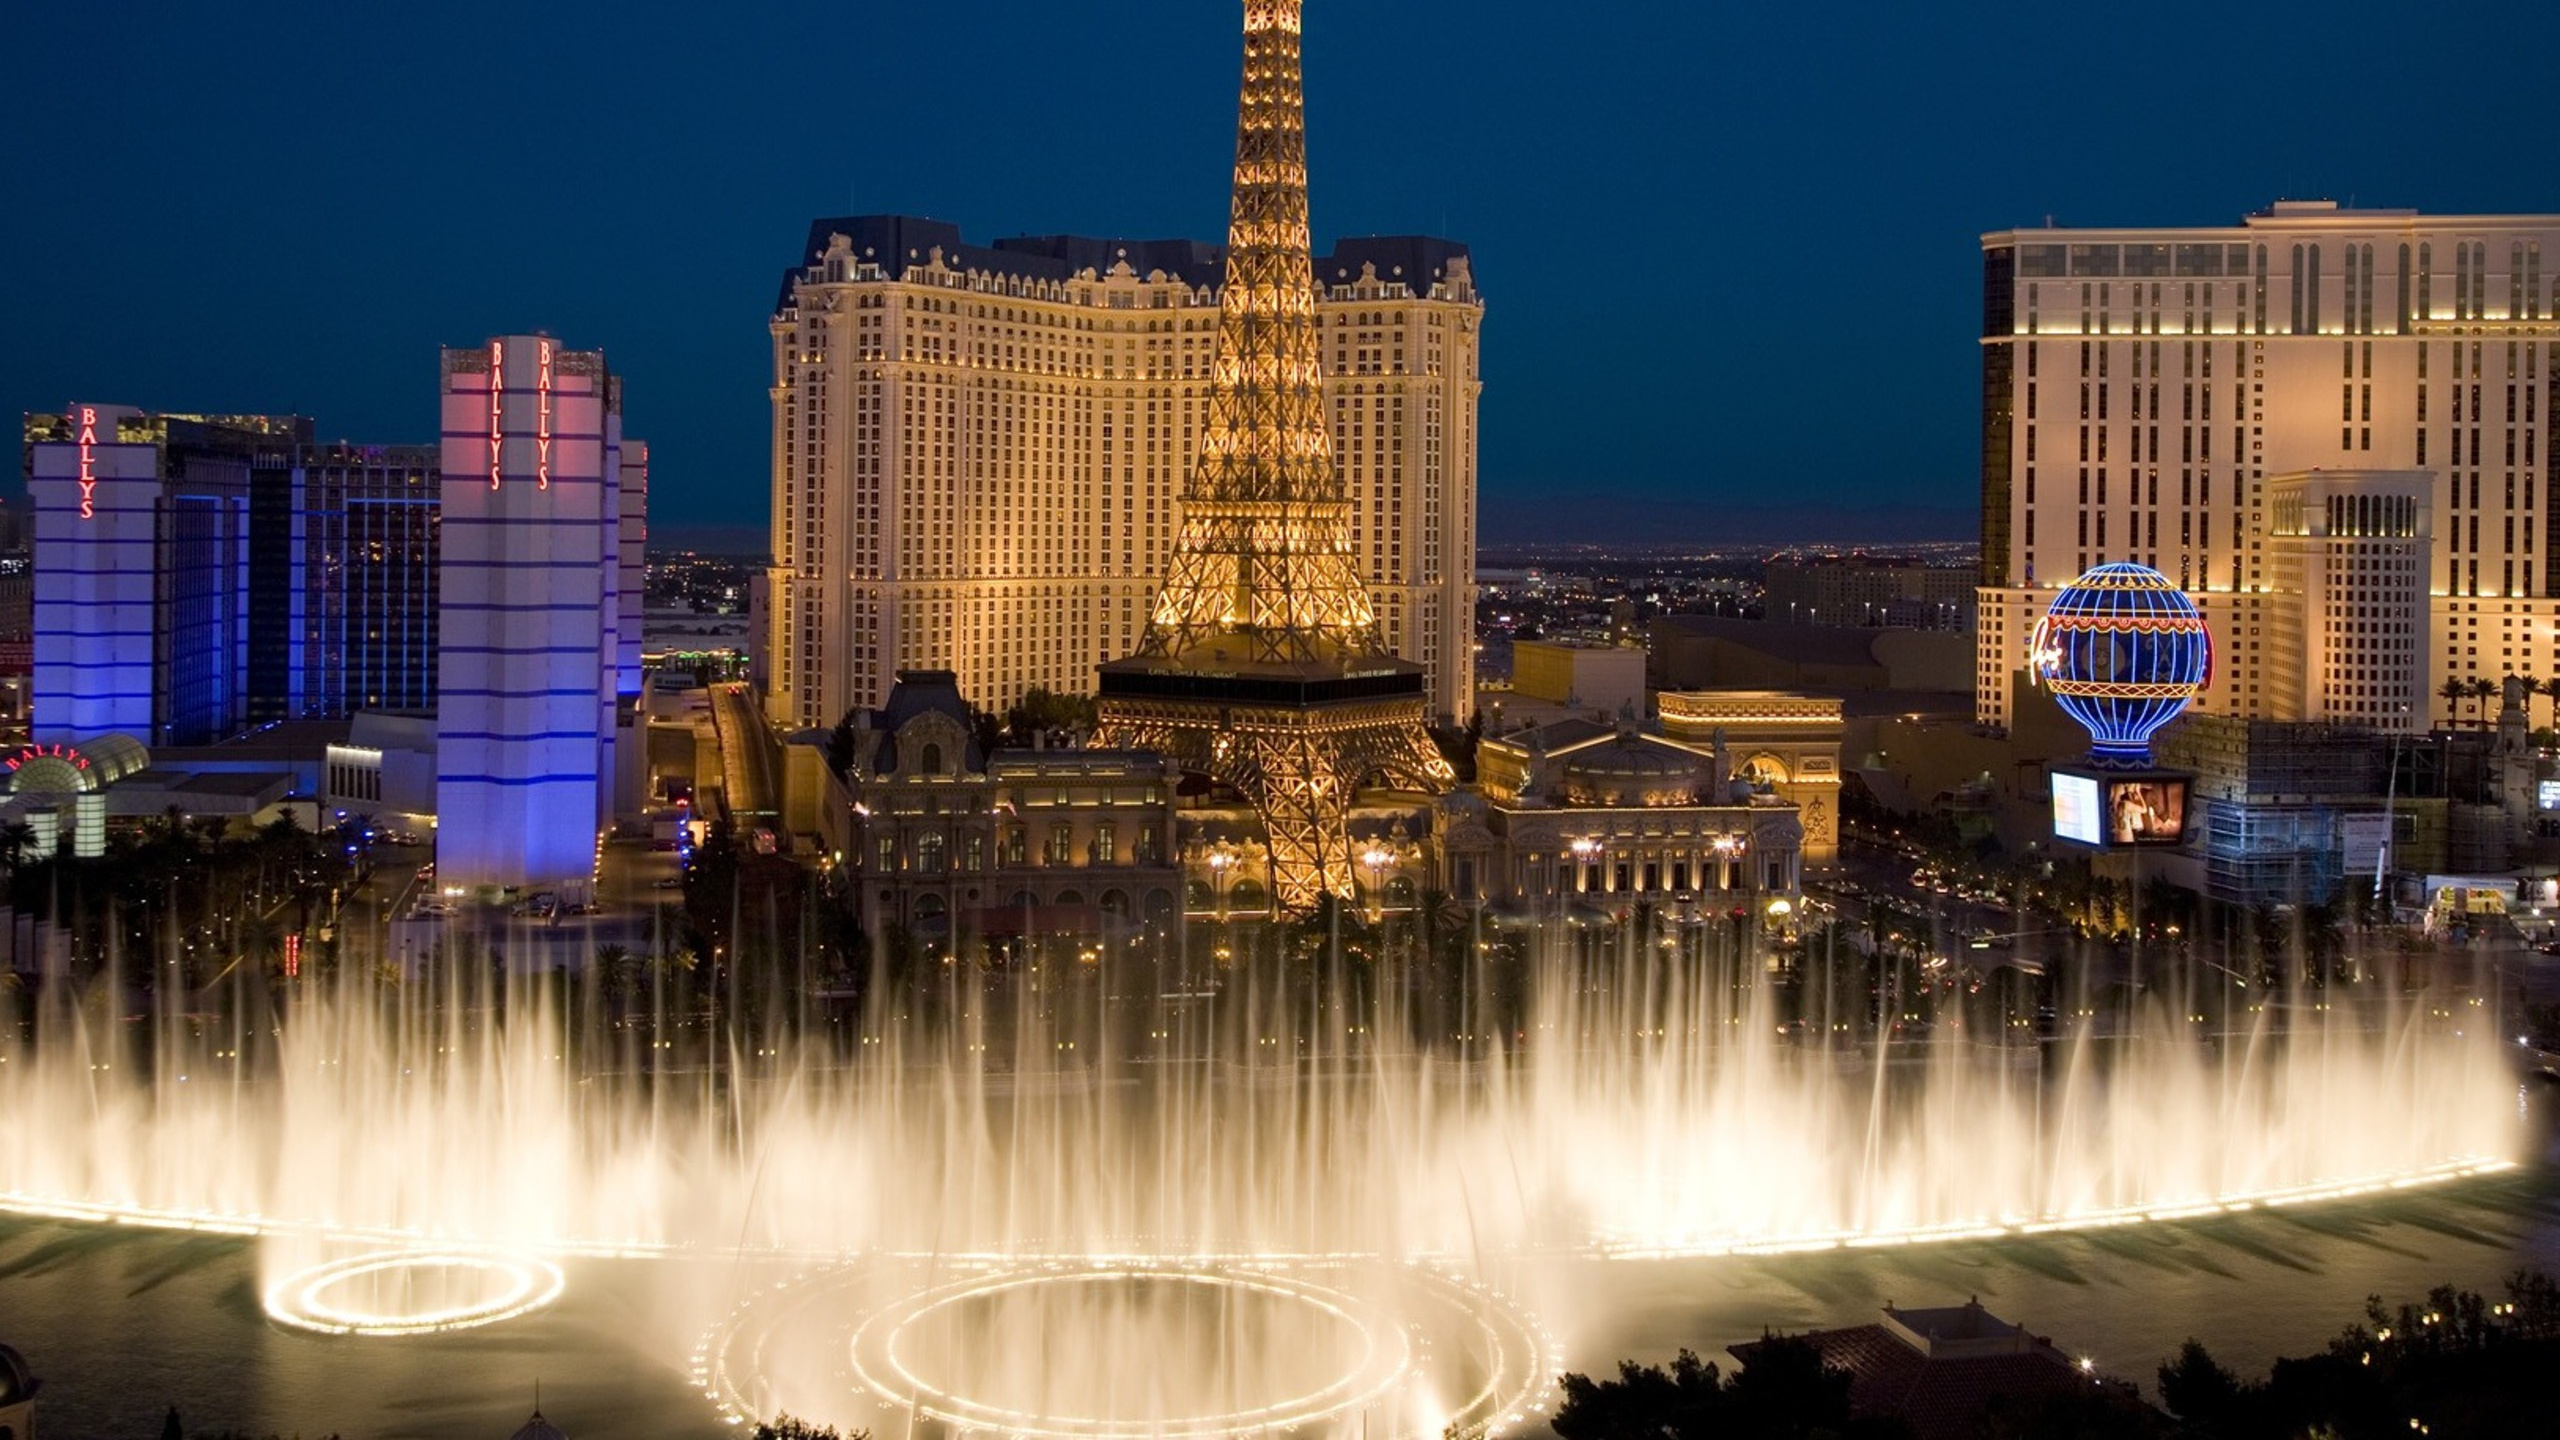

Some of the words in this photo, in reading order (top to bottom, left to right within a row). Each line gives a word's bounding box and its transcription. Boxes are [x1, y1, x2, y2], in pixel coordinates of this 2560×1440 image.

[79, 408, 98, 519] BALLYS
[491, 342, 503, 490] BALLYS
[538, 341, 551, 490] BALLYS
[5, 744, 90, 771] BALLYS
